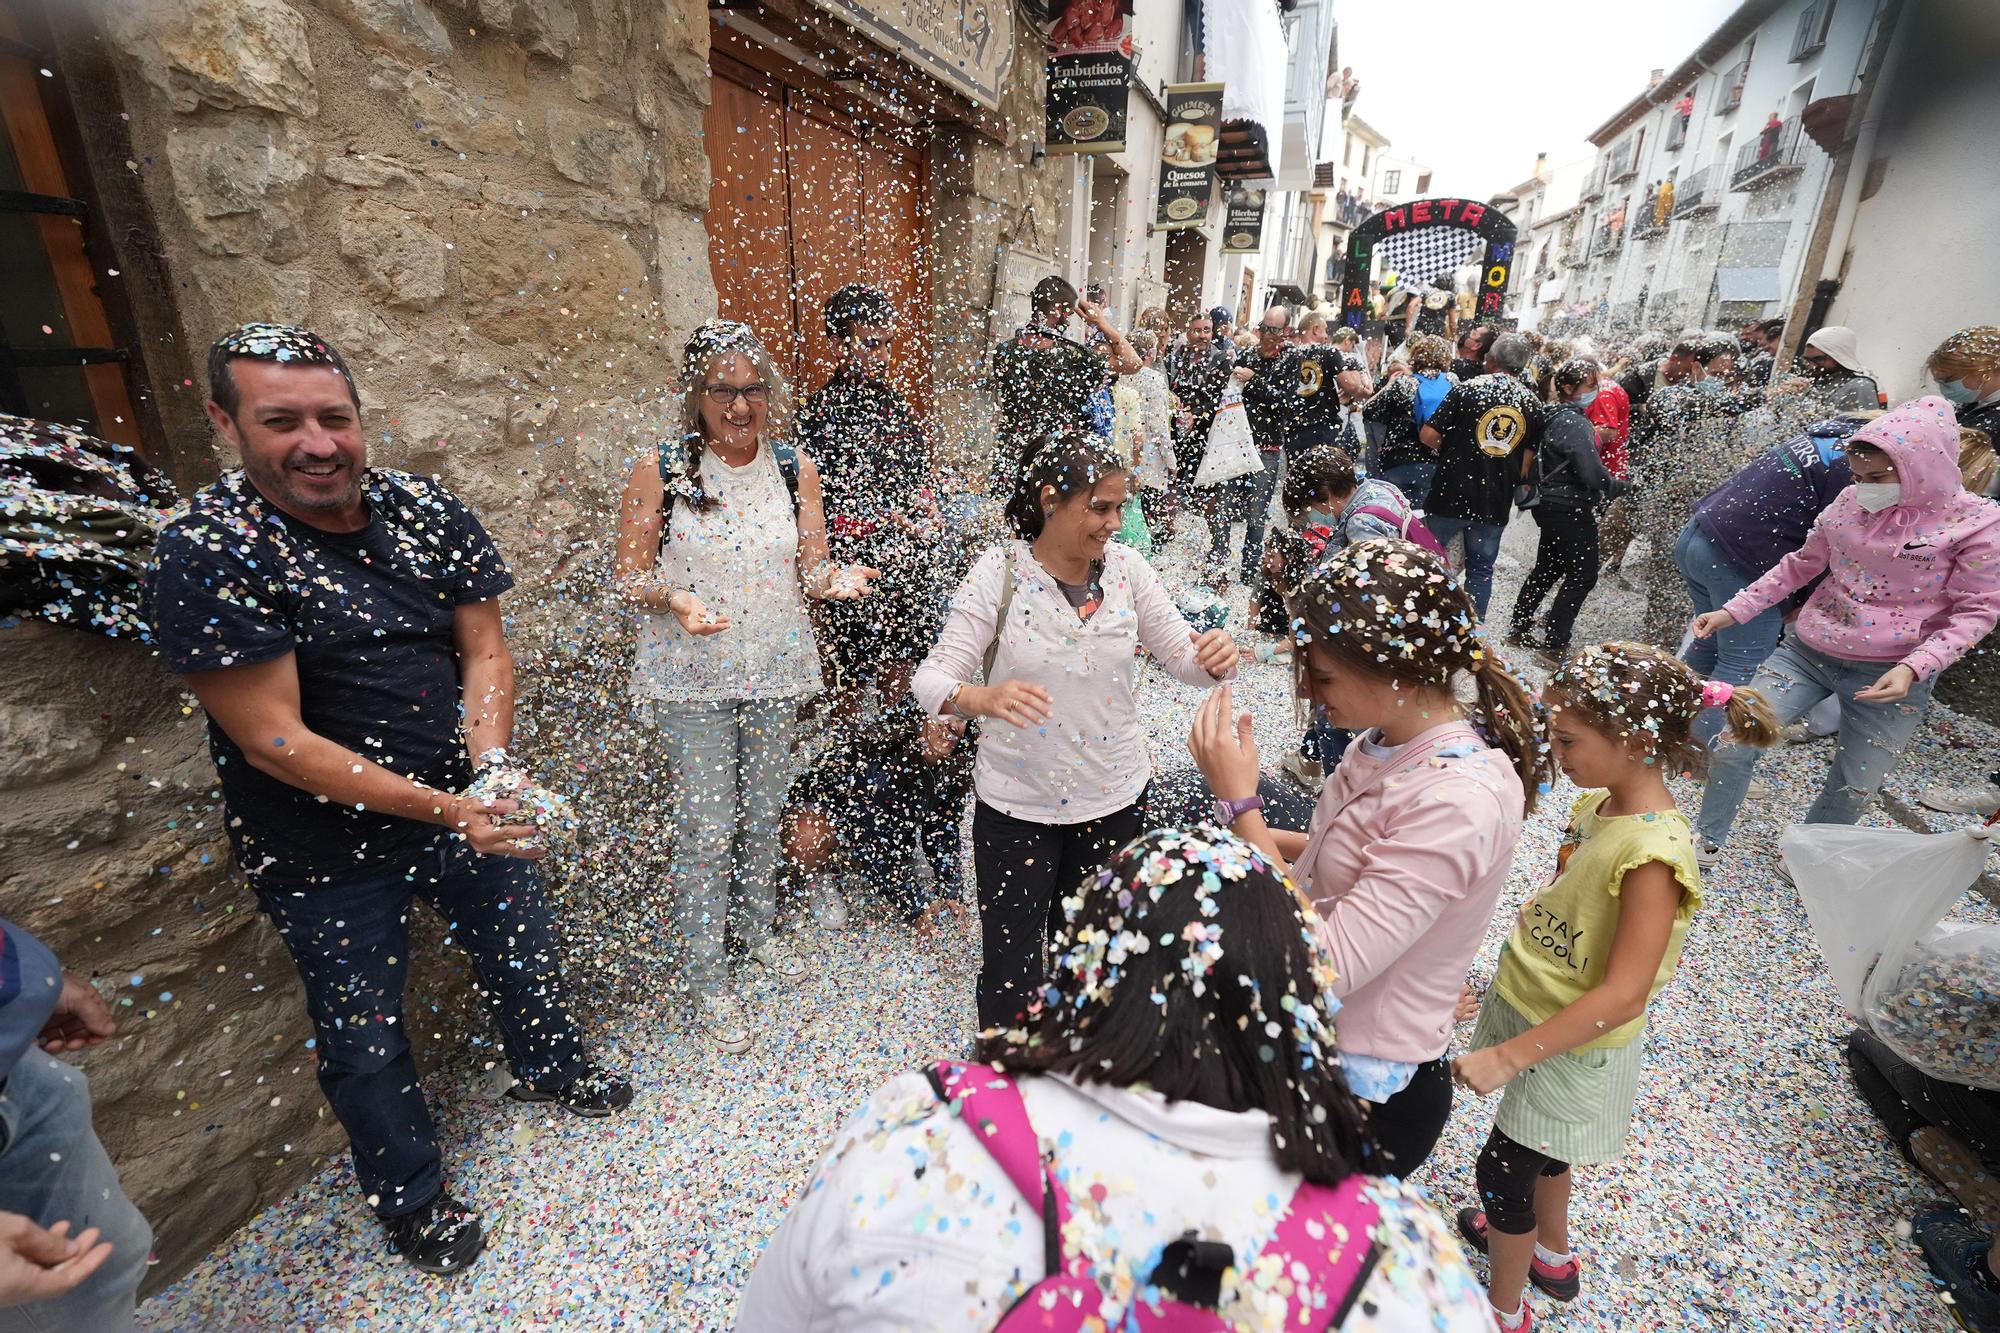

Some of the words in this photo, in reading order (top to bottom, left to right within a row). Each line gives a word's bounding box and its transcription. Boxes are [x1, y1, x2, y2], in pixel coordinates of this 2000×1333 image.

[916, 11, 932, 36] del
[933, 26, 960, 55] queso
[1054, 62, 1124, 78] Embutidos
[1079, 78, 1122, 88] comarca
[1167, 170, 1206, 182] Quesos
[1231, 209, 1260, 217] Hierbas
[1384, 199, 1486, 232] META
[1534, 903, 1584, 948] STAY
[1530, 926, 1588, 974] COOL!
